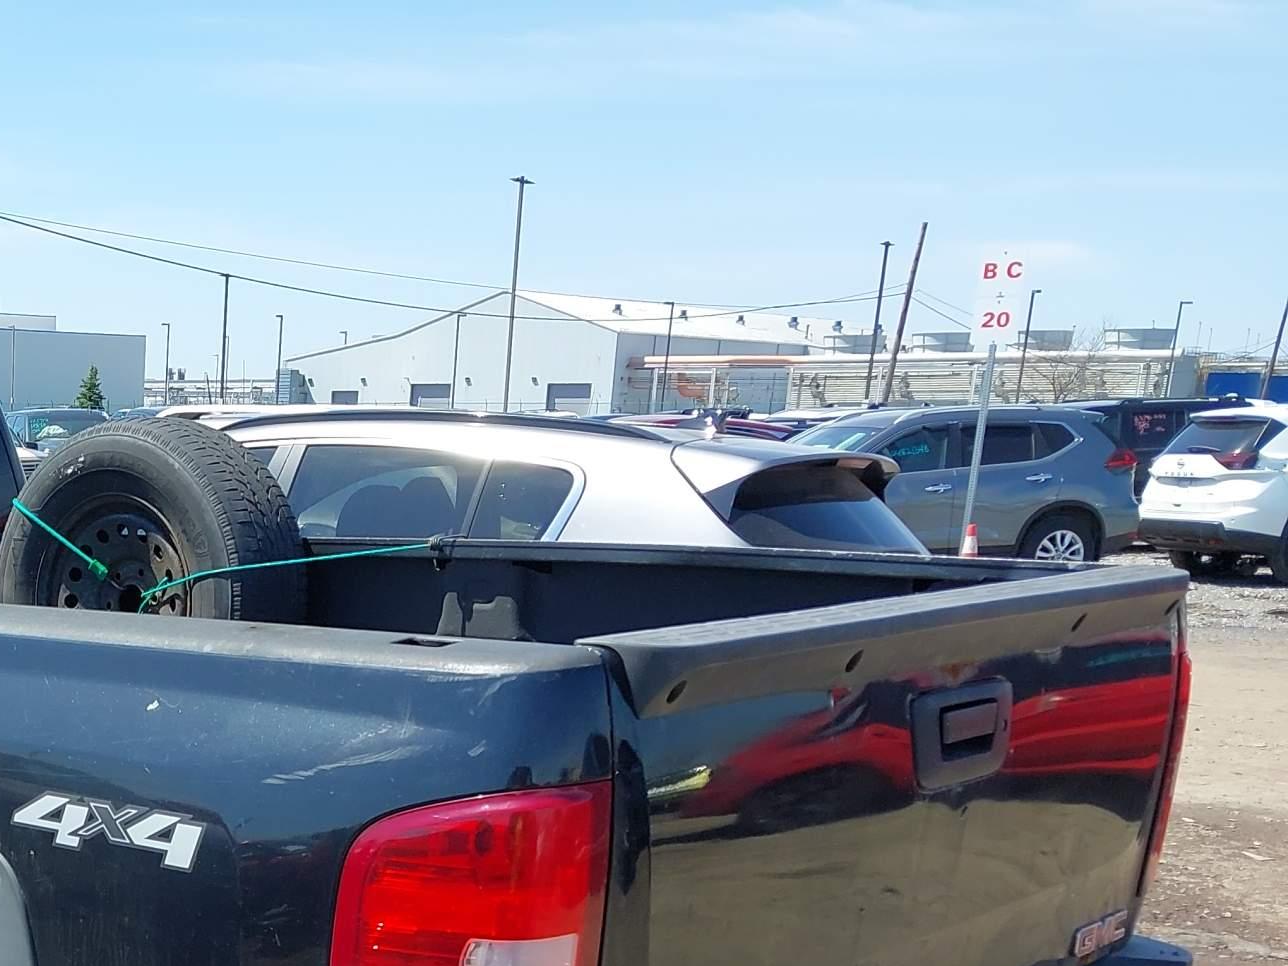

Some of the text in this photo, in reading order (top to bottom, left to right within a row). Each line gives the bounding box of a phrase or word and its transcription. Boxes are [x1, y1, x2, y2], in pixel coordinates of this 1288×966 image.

[983, 261, 1023, 279] B C
[981, 311, 1010, 328] 20
[1073, 909, 1128, 958] GMC
